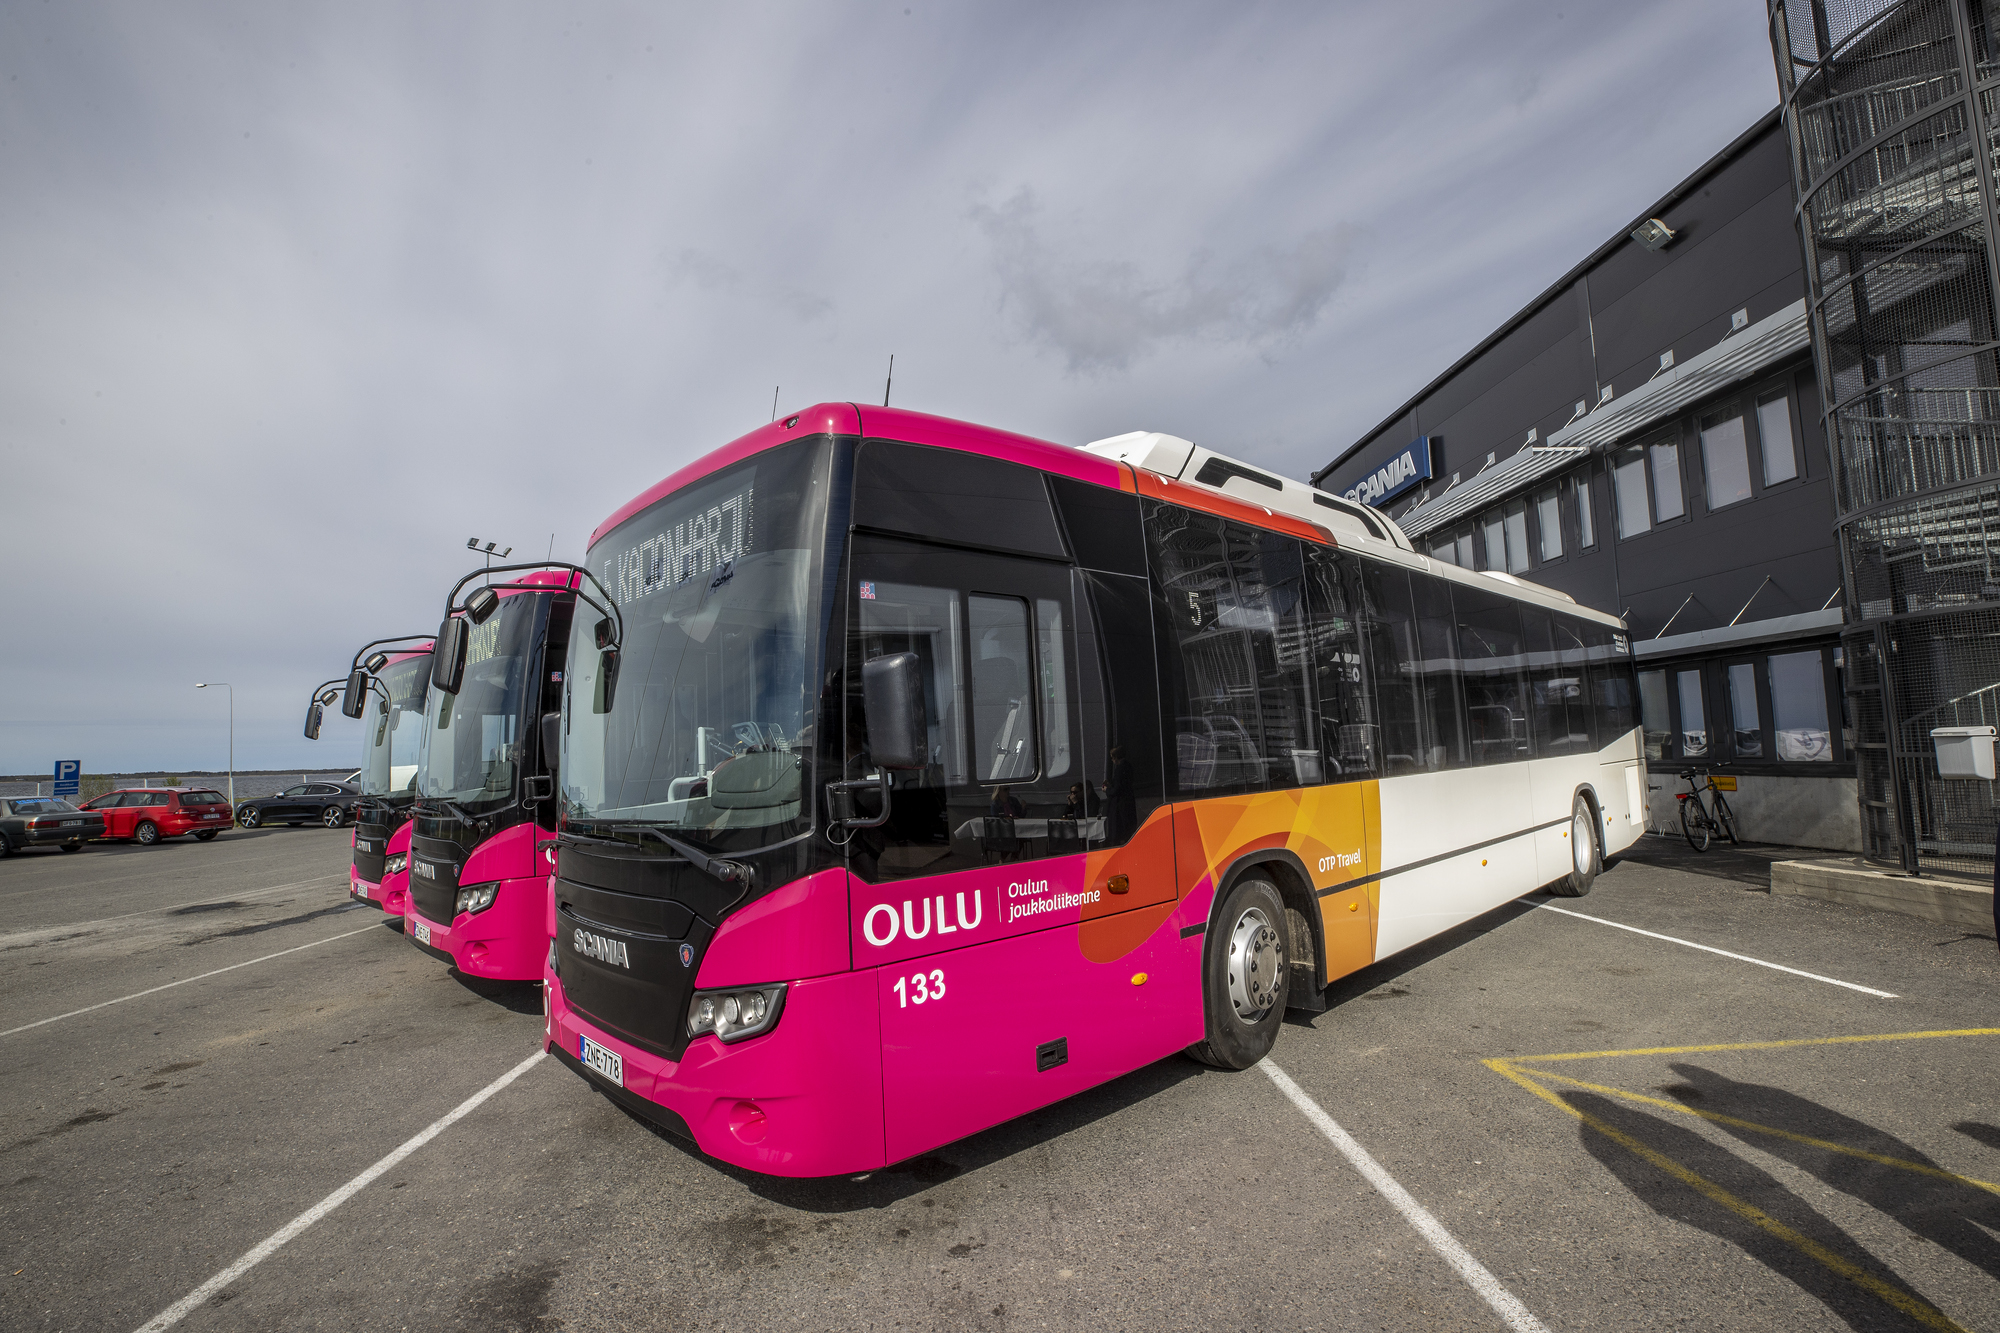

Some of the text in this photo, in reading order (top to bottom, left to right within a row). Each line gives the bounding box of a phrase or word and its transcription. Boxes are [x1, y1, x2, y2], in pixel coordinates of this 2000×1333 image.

[1189, 592, 1202, 626] 5
[59, 762, 77, 780] P
[414, 860, 435, 880] SCANIA
[1318, 848, 1362, 873] OTP Travel
[1008, 879, 1048, 898] Oulun
[863, 890, 982, 946] OULU
[1008, 890, 1101, 923] joukkoliikenne
[573, 928, 630, 969] SCANIA
[893, 969, 946, 1008] 133
[585, 1042, 620, 1080] ZNE-778
